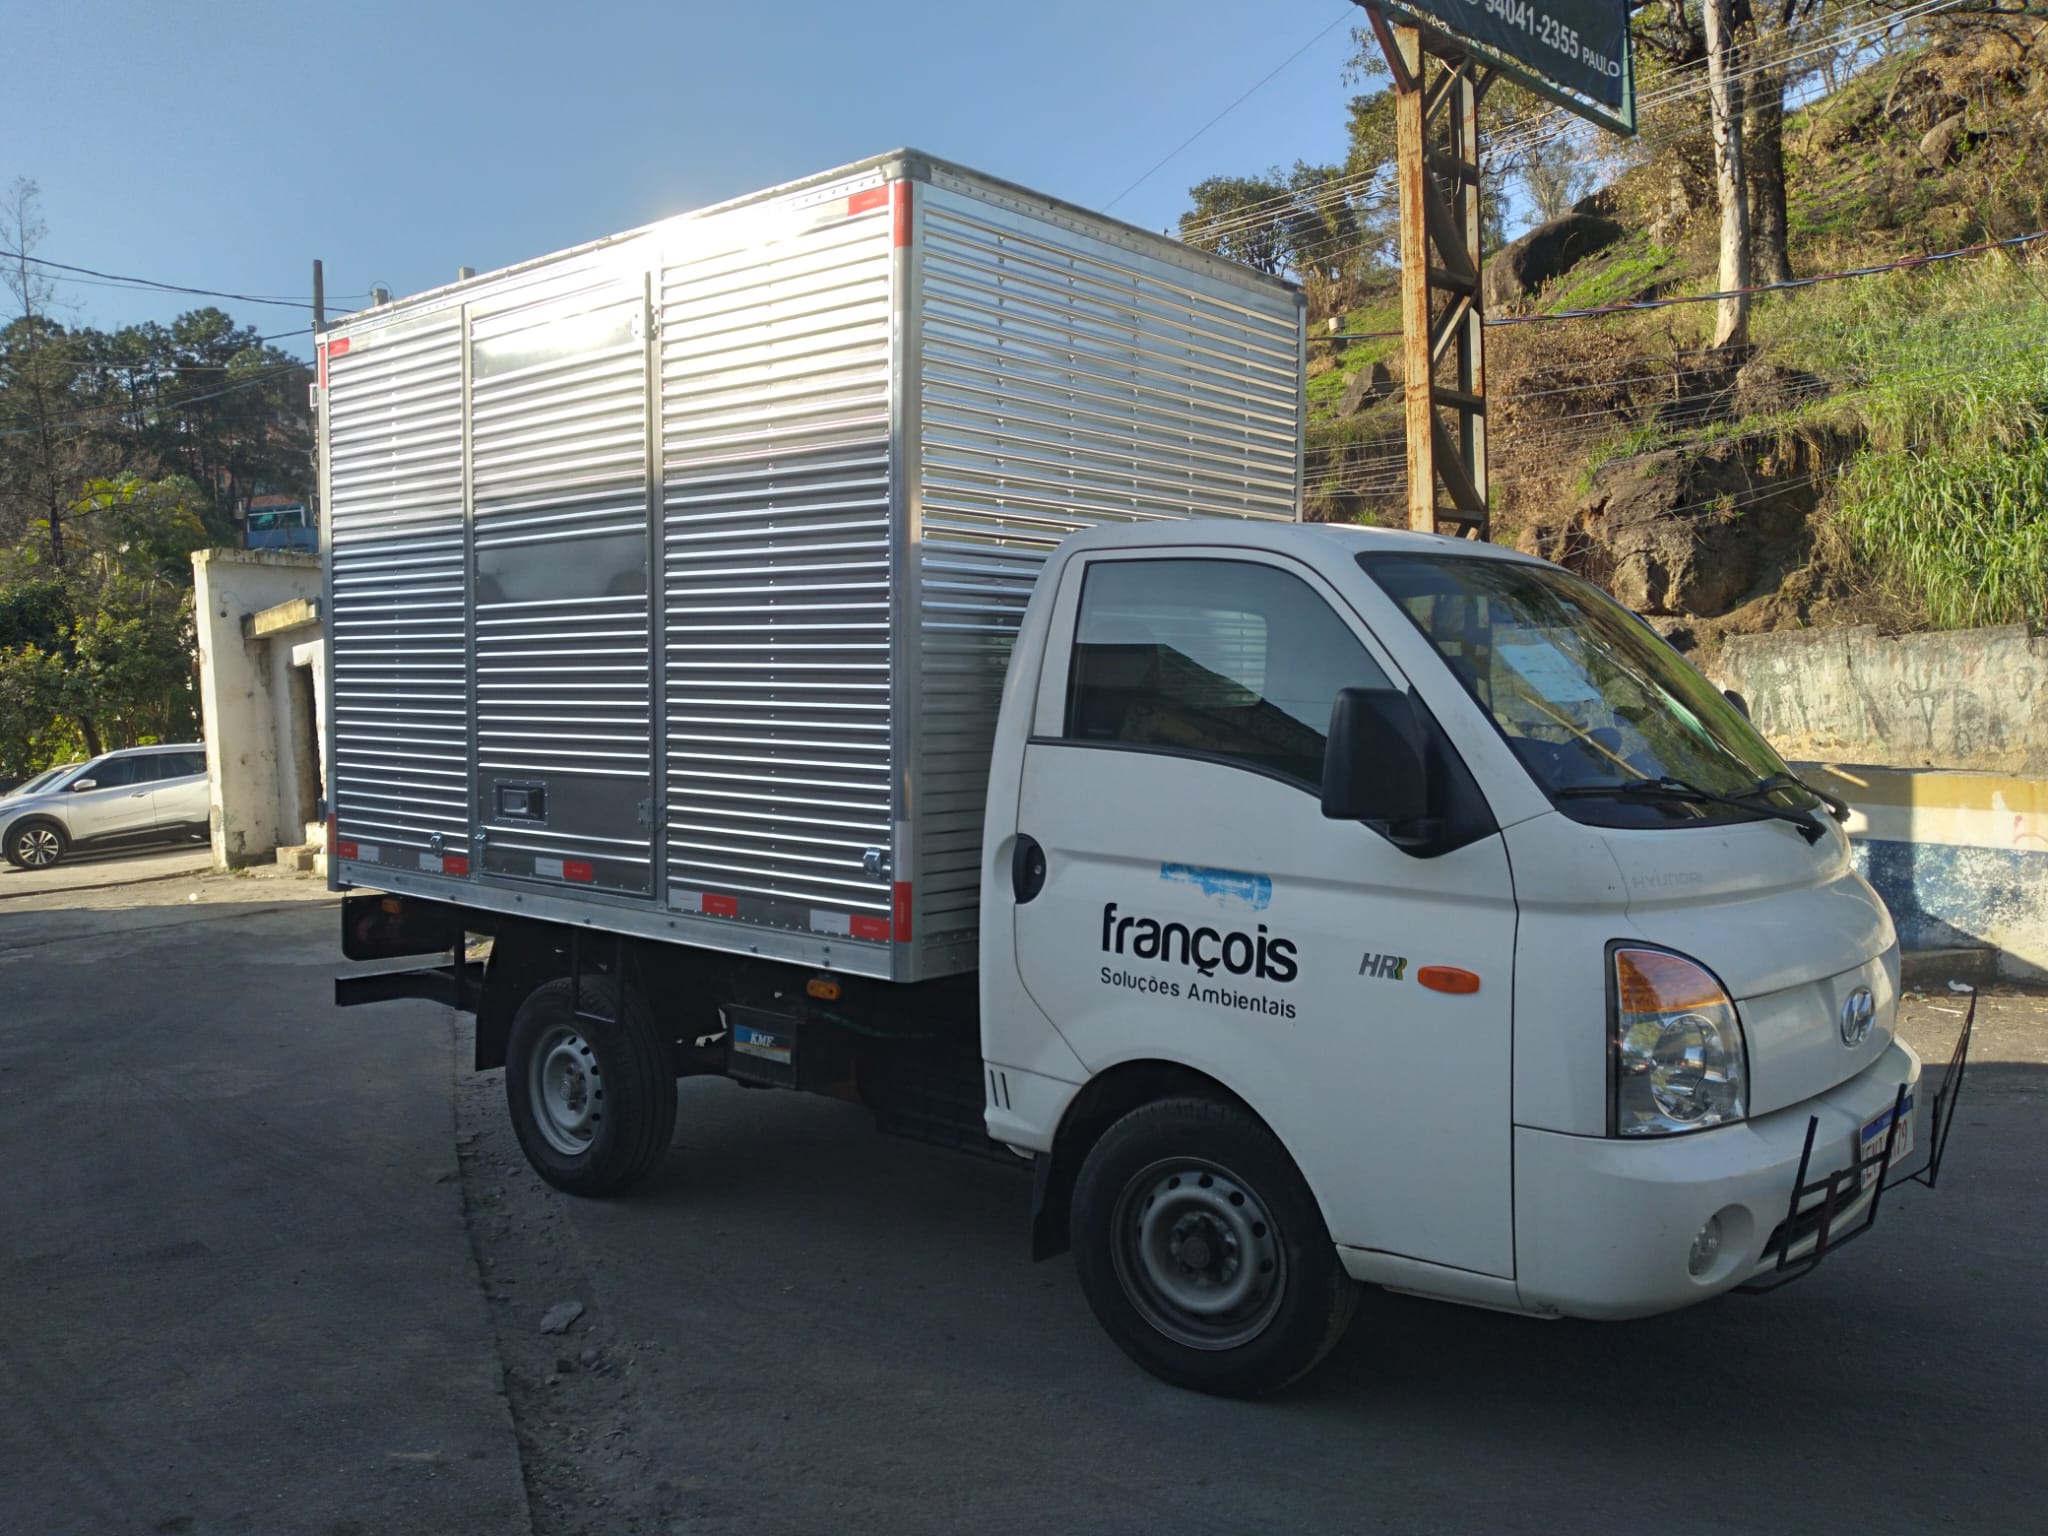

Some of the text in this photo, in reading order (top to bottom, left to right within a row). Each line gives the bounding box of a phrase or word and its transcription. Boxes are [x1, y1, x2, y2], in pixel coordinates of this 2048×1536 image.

[1583, 46, 1620, 77] PAULO
[1102, 903, 1298, 982] françois
[1101, 967, 1296, 1019] Soluções Ambientais
